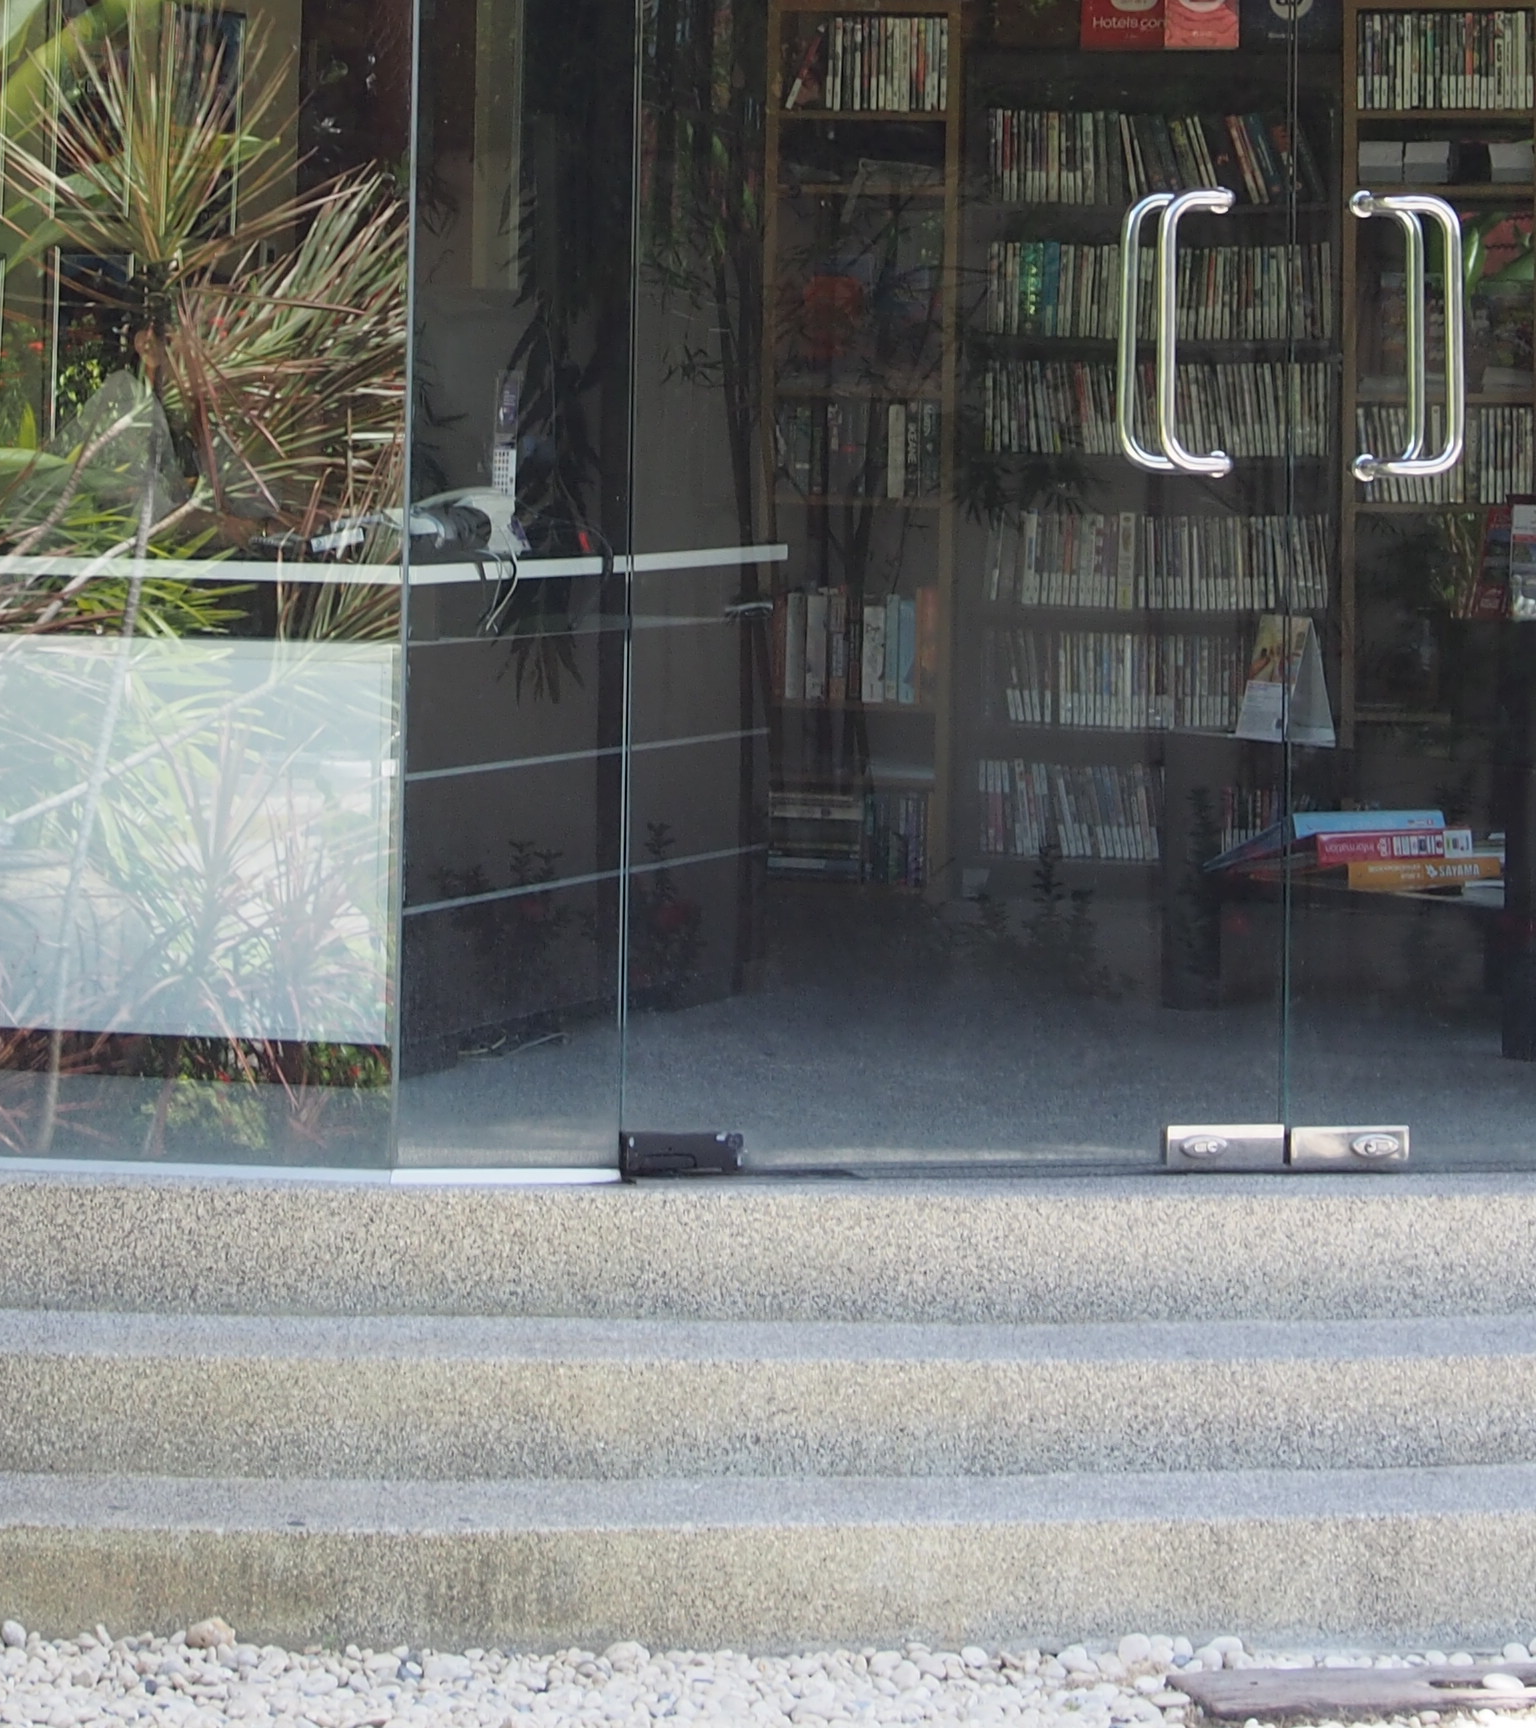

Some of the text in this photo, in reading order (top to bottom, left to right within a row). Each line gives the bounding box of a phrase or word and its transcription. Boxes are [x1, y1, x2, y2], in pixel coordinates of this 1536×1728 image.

[907, 423, 918, 465] KEANE
[1324, 841, 1376, 855] Information
[1438, 862, 1481, 878] SAYAMA
